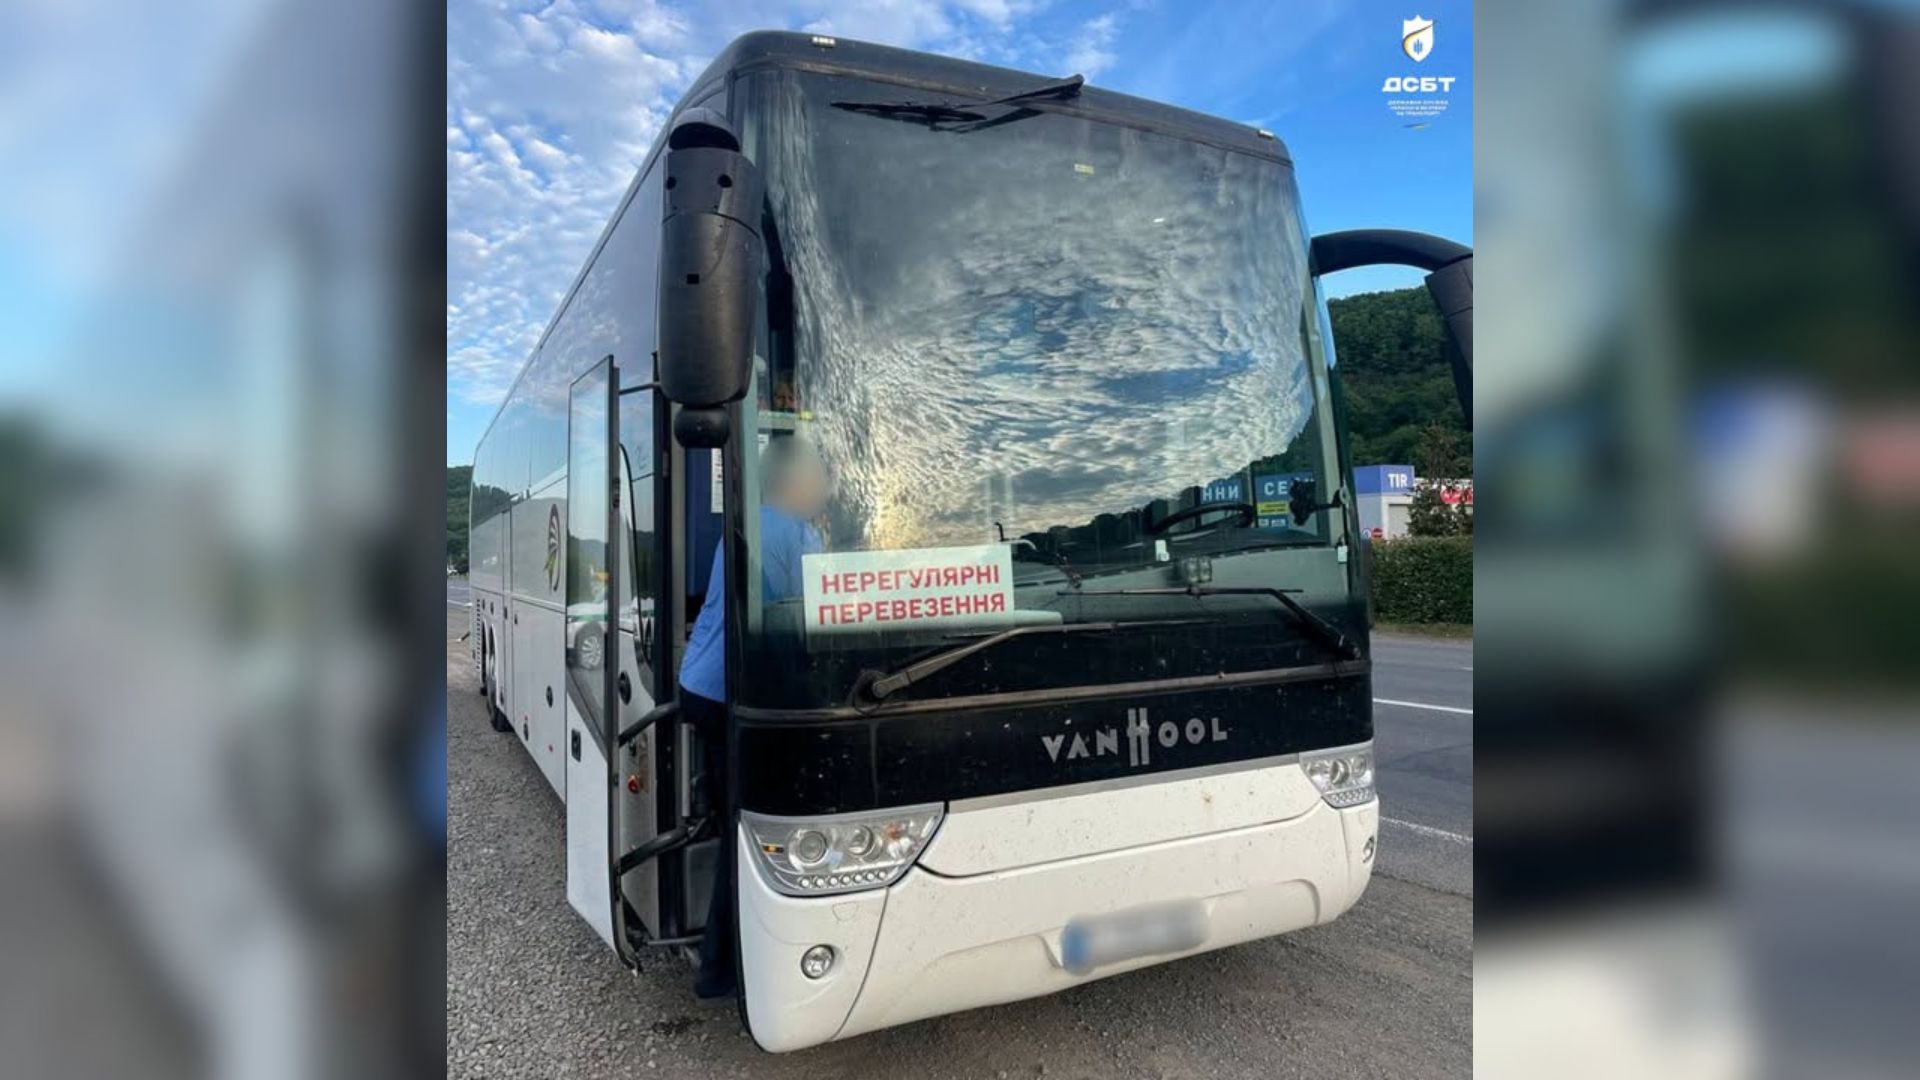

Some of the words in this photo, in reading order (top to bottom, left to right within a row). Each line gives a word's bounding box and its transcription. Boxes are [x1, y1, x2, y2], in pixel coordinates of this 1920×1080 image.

[1387, 473, 1408, 489] TIR
[1202, 485, 1239, 501] ННИ
[821, 564, 1000, 595] НЕРЕГУЛЯРНІ
[818, 592, 1006, 625] ПЕРЕВЕЗЕННЯ
